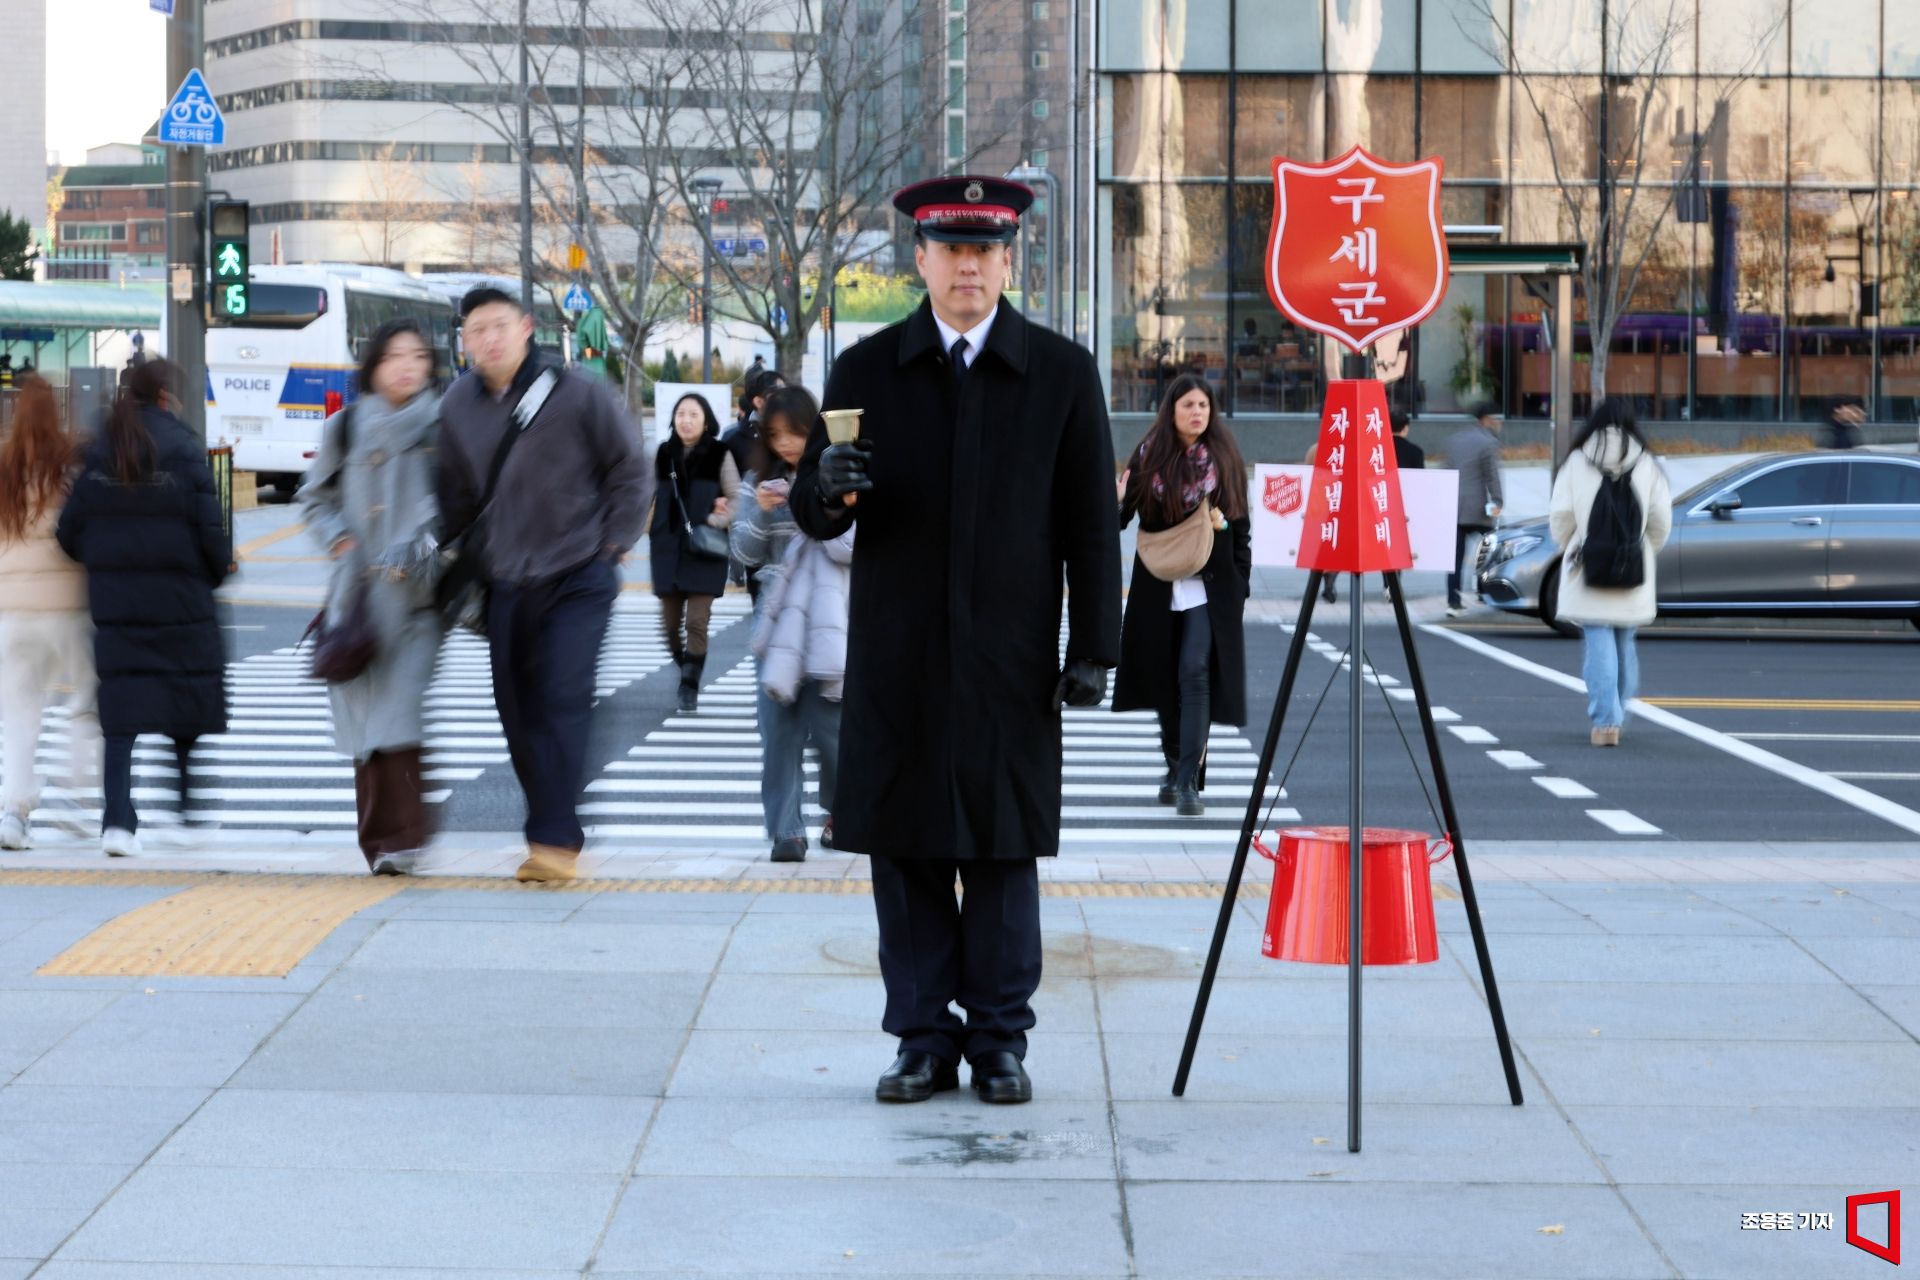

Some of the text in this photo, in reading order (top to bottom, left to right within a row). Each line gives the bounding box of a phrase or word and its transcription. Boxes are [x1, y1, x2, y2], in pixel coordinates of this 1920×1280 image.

[1329, 176, 1387, 326] 구세군
[224, 378, 271, 391] POLICE
[1269, 476, 1286, 491] THE
[1276, 493, 1299, 511] ARMY
[1320, 407, 1350, 551] 자선냄비
[1365, 407, 1391, 551] 자선냄비
